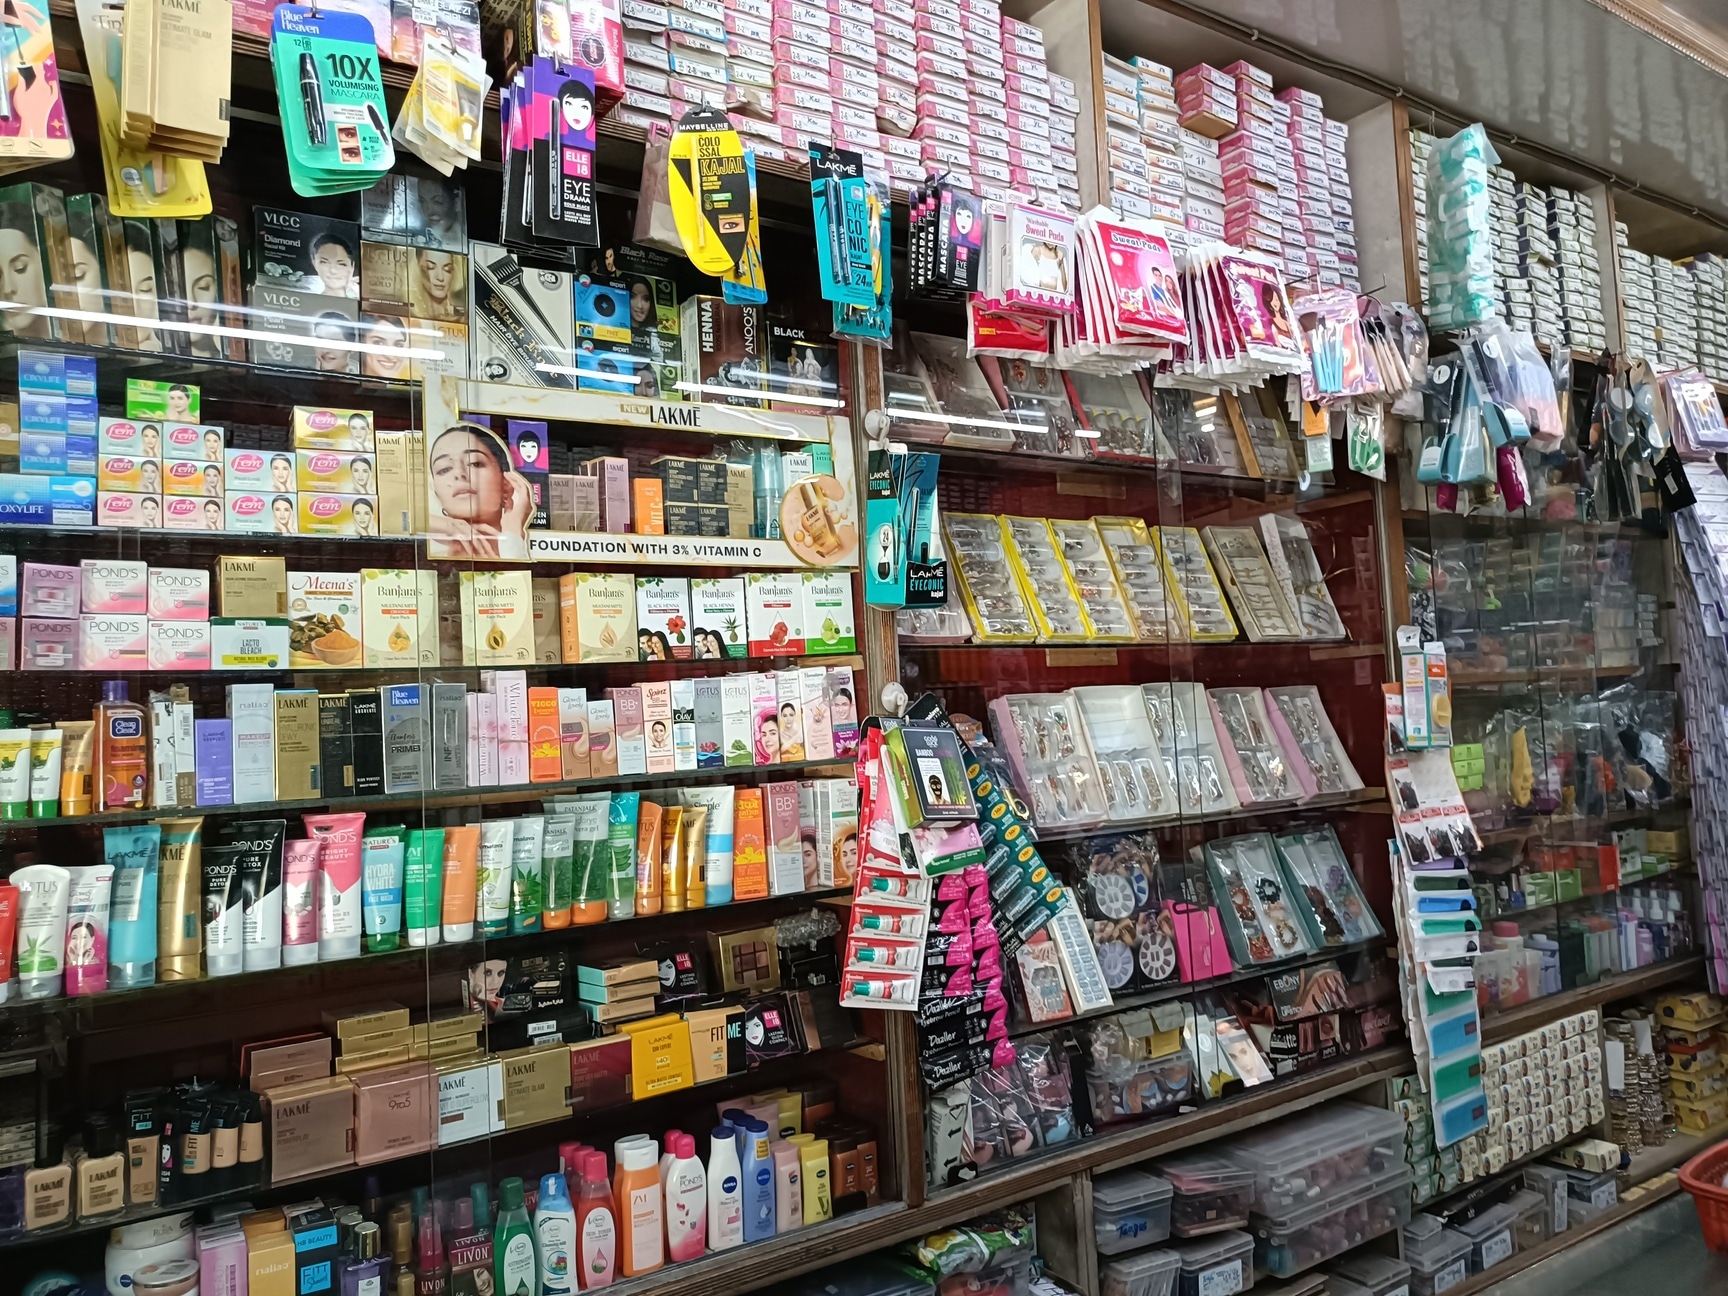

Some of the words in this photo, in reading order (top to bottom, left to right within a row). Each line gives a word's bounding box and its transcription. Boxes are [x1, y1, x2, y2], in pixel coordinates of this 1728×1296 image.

[280, 9, 303, 23] Blue
[281, 20, 320, 34] Heaven
[324, 53, 376, 82] 10X
[329, 80, 380, 92] VOLUMISING
[330, 88, 381, 100] MASCARA
[679, 122, 729, 132] MAYBELLINE
[698, 136, 721, 148] COLO
[565, 151, 588, 164] ELLE
[699, 147, 722, 158] SSAL
[576, 164, 589, 176] 18
[700, 157, 746, 176] KAJAL
[563, 178, 591, 197] EYE
[563, 193, 591, 204] DRAMA
[846, 201, 864, 220] EYE
[263, 211, 300, 227] VLCC
[848, 218, 863, 236] CO
[1025, 223, 1047, 239] Sweat
[1048, 229, 1065, 243] Pads
[263, 234, 301, 247] Diamond
[849, 237, 868, 254] NIC
[1112, 233, 1139, 246] Sweat
[1141, 241, 1162, 253] Pads
[940, 219, 950, 275] MASCARA
[609, 280, 627, 290] expert
[855, 272, 868, 287] 24
[263, 292, 300, 308] VLCC
[489, 315, 507, 336] HAIR
[505, 331, 520, 350] DYE
[702, 301, 714, 353] HENNA
[773, 326, 806, 340] BLACK
[623, 405, 648, 415] NEW
[309, 412, 337, 427] fem
[108, 425, 137, 438] fem
[171, 430, 198, 442] fem
[107, 459, 134, 471] fem
[232, 455, 263, 470] fem
[310, 455, 340, 470] fem
[171, 464, 196, 475] fem
[869, 480, 891, 491] EYECONIC
[104, 496, 133, 509] fem
[168, 500, 196, 512] fem
[233, 497, 264, 512] fem
[311, 499, 341, 513] fem
[0, 504, 45, 514] OXYLIFE
[882, 531, 890, 543] 24
[530, 539, 627, 554] FOUNDATION
[631, 542, 668, 555] WITH
[671, 545, 690, 556] 3%
[694, 545, 750, 558] VITAMIN
[752, 547, 762, 558] C
[32, 568, 74, 581] POND'S
[91, 567, 139, 579] POND'S
[156, 575, 202, 587] POND'S
[291, 575, 354, 591] Meena's
[909, 578, 945, 592] EYECONIC
[377, 585, 424, 599] Banjara's
[473, 585, 518, 598] Banjara's
[588, 587, 625, 599] Banjara's
[645, 588, 680, 600] Banjara's
[701, 588, 736, 600] Banjara's
[759, 585, 793, 597] Banjara's
[811, 584, 844, 596] Banjara's
[29, 623, 73, 634] POND'S
[89, 620, 141, 633] POND'S
[157, 627, 205, 639] POND'S
[241, 639, 260, 648] LACTO
[239, 646, 263, 655] BLEACH
[391, 690, 408, 699] Blue
[391, 696, 420, 706] Heaven
[531, 700, 558, 709] VICCO
[675, 713, 692, 721] OLAY
[770, 784, 797, 793] POND'S
[693, 801, 721, 811] Simple
[231, 839, 273, 852] POND'S
[362, 837, 397, 846] NATURE'S
[204, 864, 237, 874] POND'S
[366, 863, 396, 878] HYDRA
[368, 877, 395, 890] WHITE
[676, 953, 690, 963] ELLE
[683, 960, 692, 968] 18
[1273, 975, 1300, 990] EBONY
[764, 1011, 779, 1021] ELLE
[771, 1018, 781, 1026] 18
[711, 1024, 726, 1044] FIT
[727, 1021, 743, 1040] ME
[928, 1031, 957, 1047] Dazller
[934, 1061, 961, 1078] Dazller
[723, 1181, 737, 1189] NIVEA
[308, 1233, 333, 1245] BEAUTY
[457, 1246, 489, 1265] LIVON
